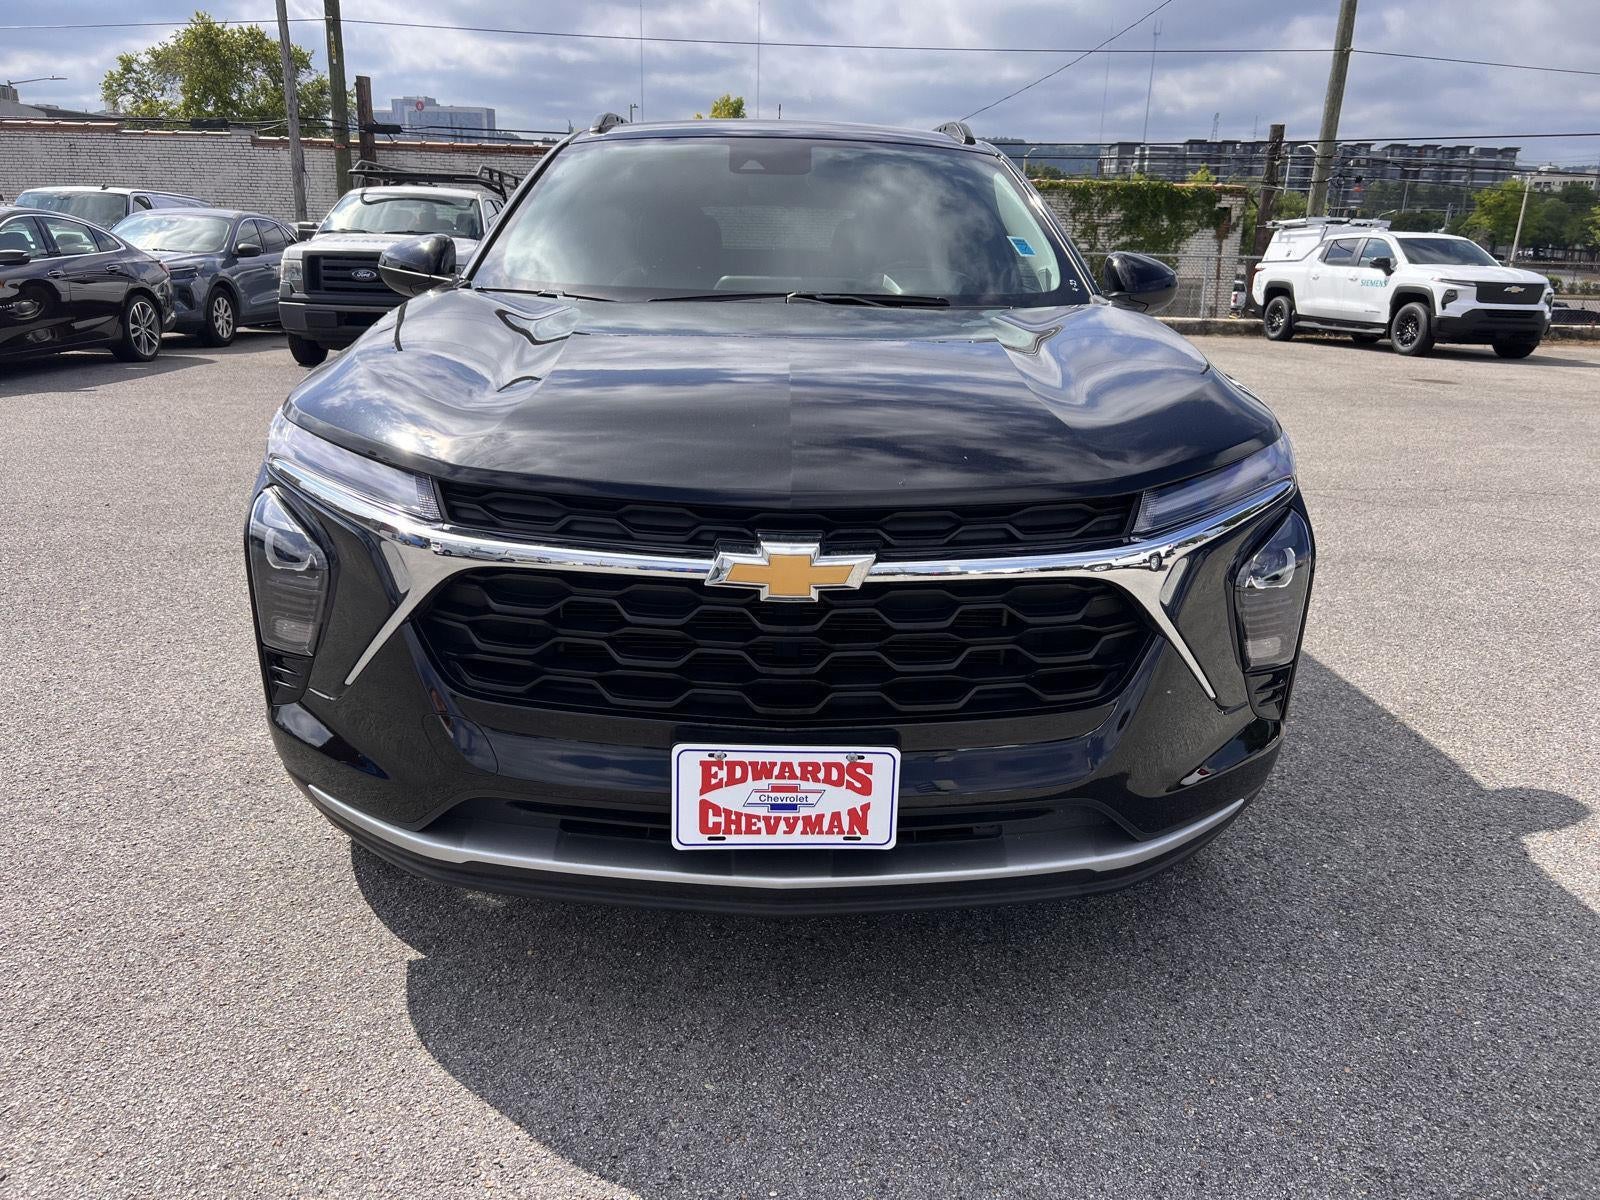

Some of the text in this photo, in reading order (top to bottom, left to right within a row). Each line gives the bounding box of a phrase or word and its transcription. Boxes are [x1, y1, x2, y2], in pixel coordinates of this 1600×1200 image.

[1360, 279, 1388, 288] SIEMENS
[699, 759, 873, 797] EDWARDS
[758, 793, 809, 803] Chevrolet
